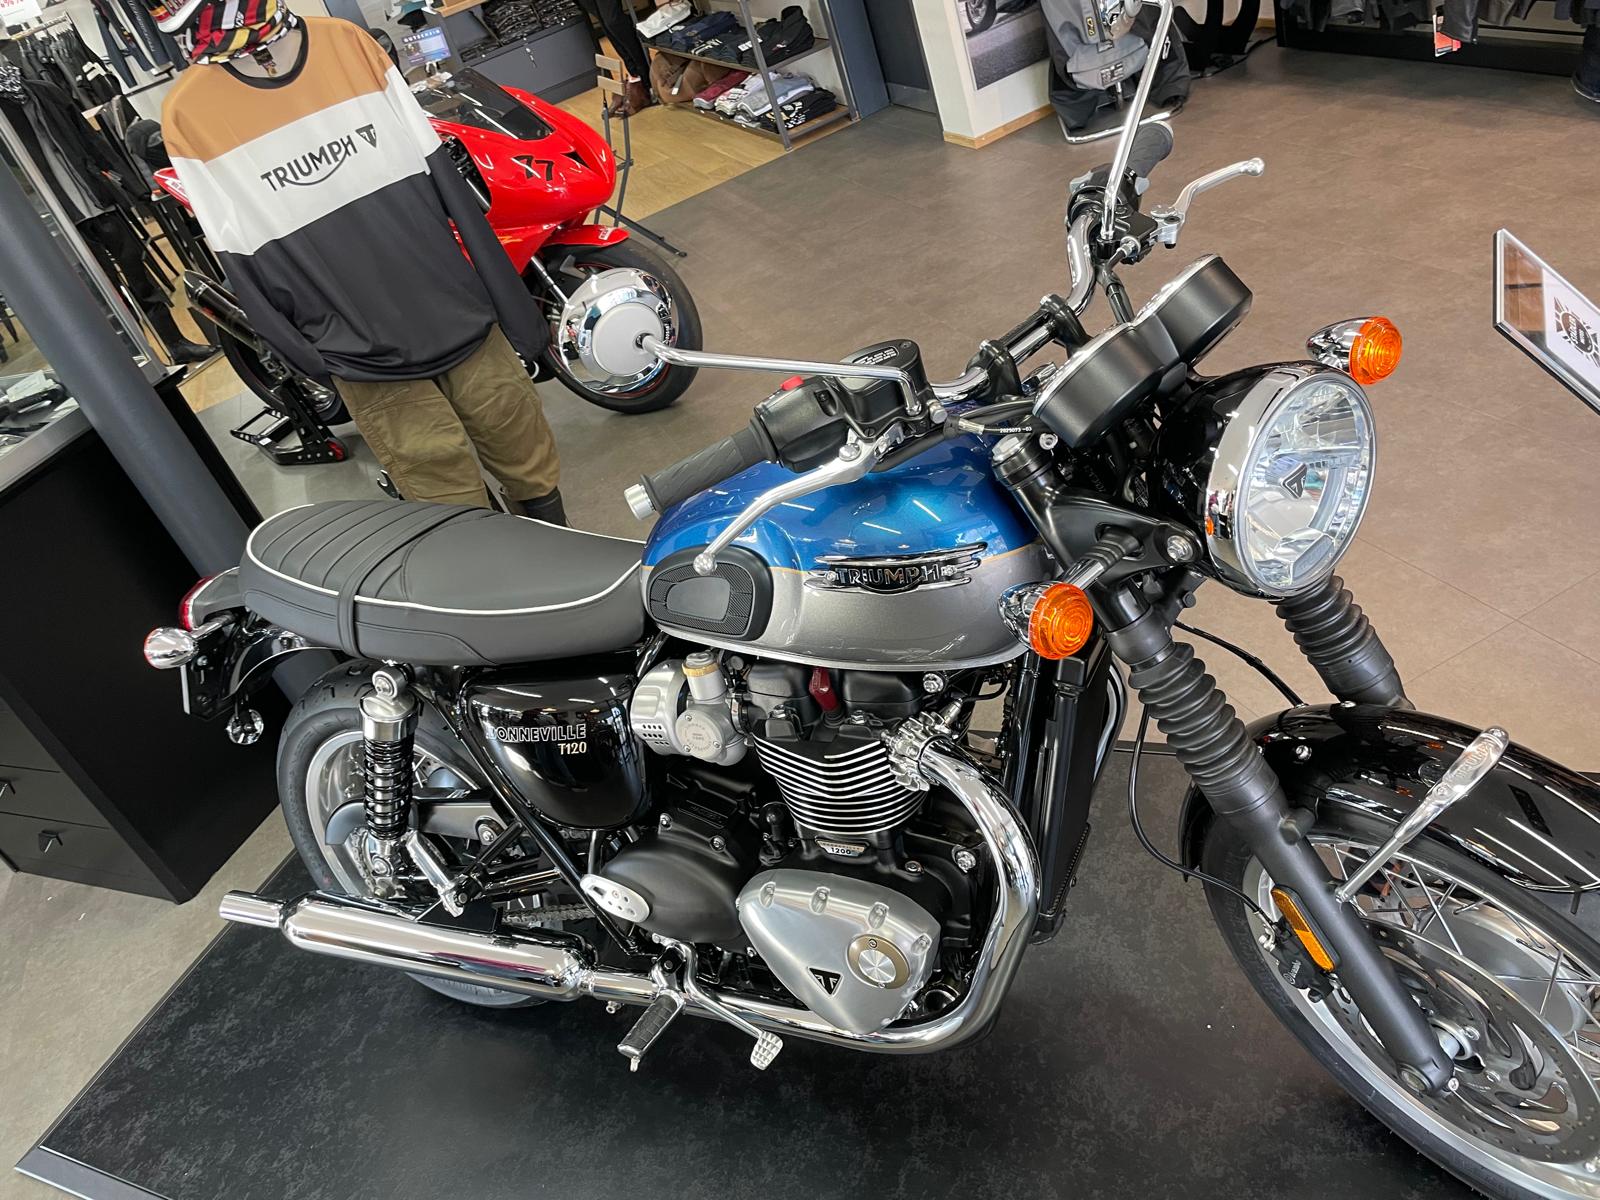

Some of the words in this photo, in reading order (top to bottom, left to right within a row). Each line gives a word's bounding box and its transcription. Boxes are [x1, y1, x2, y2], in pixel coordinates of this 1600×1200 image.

[260, 134, 358, 192] TRIUMPH
[511, 154, 554, 182] 77
[834, 562, 941, 593] TRIUMPH
[557, 741, 588, 756] T120
[830, 847, 852, 855] 1200
